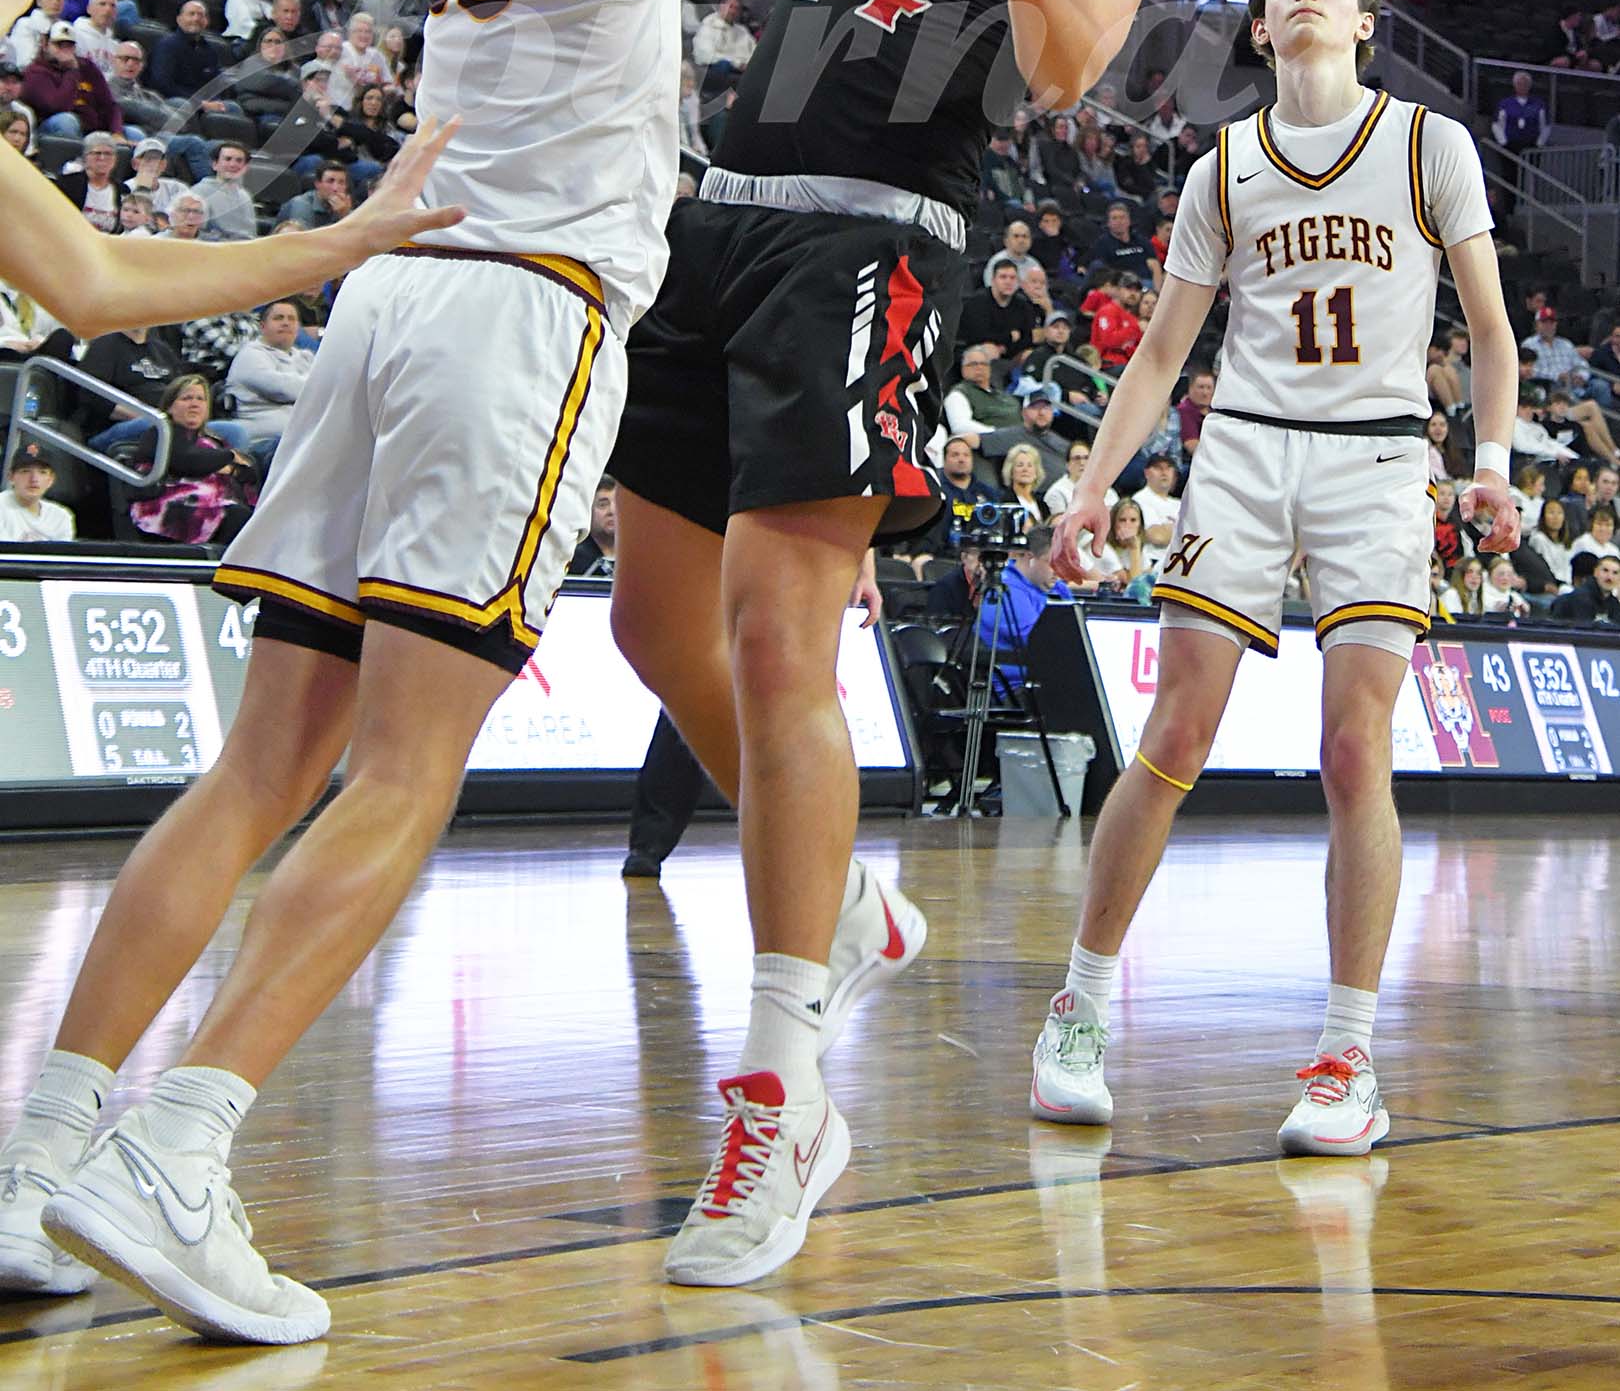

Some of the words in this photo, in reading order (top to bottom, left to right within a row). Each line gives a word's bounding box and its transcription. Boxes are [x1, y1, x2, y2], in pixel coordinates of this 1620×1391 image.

[1256, 214, 1395, 277] TIGERS
[1290, 285, 1361, 366] 11
[86, 608, 170, 654] 5:52
[1482, 652, 1512, 693] 43
[1528, 657, 1573, 691] 5:52
[1591, 659, 1620, 697] 42
[98, 710, 117, 739] 0
[175, 711, 192, 738] 2
